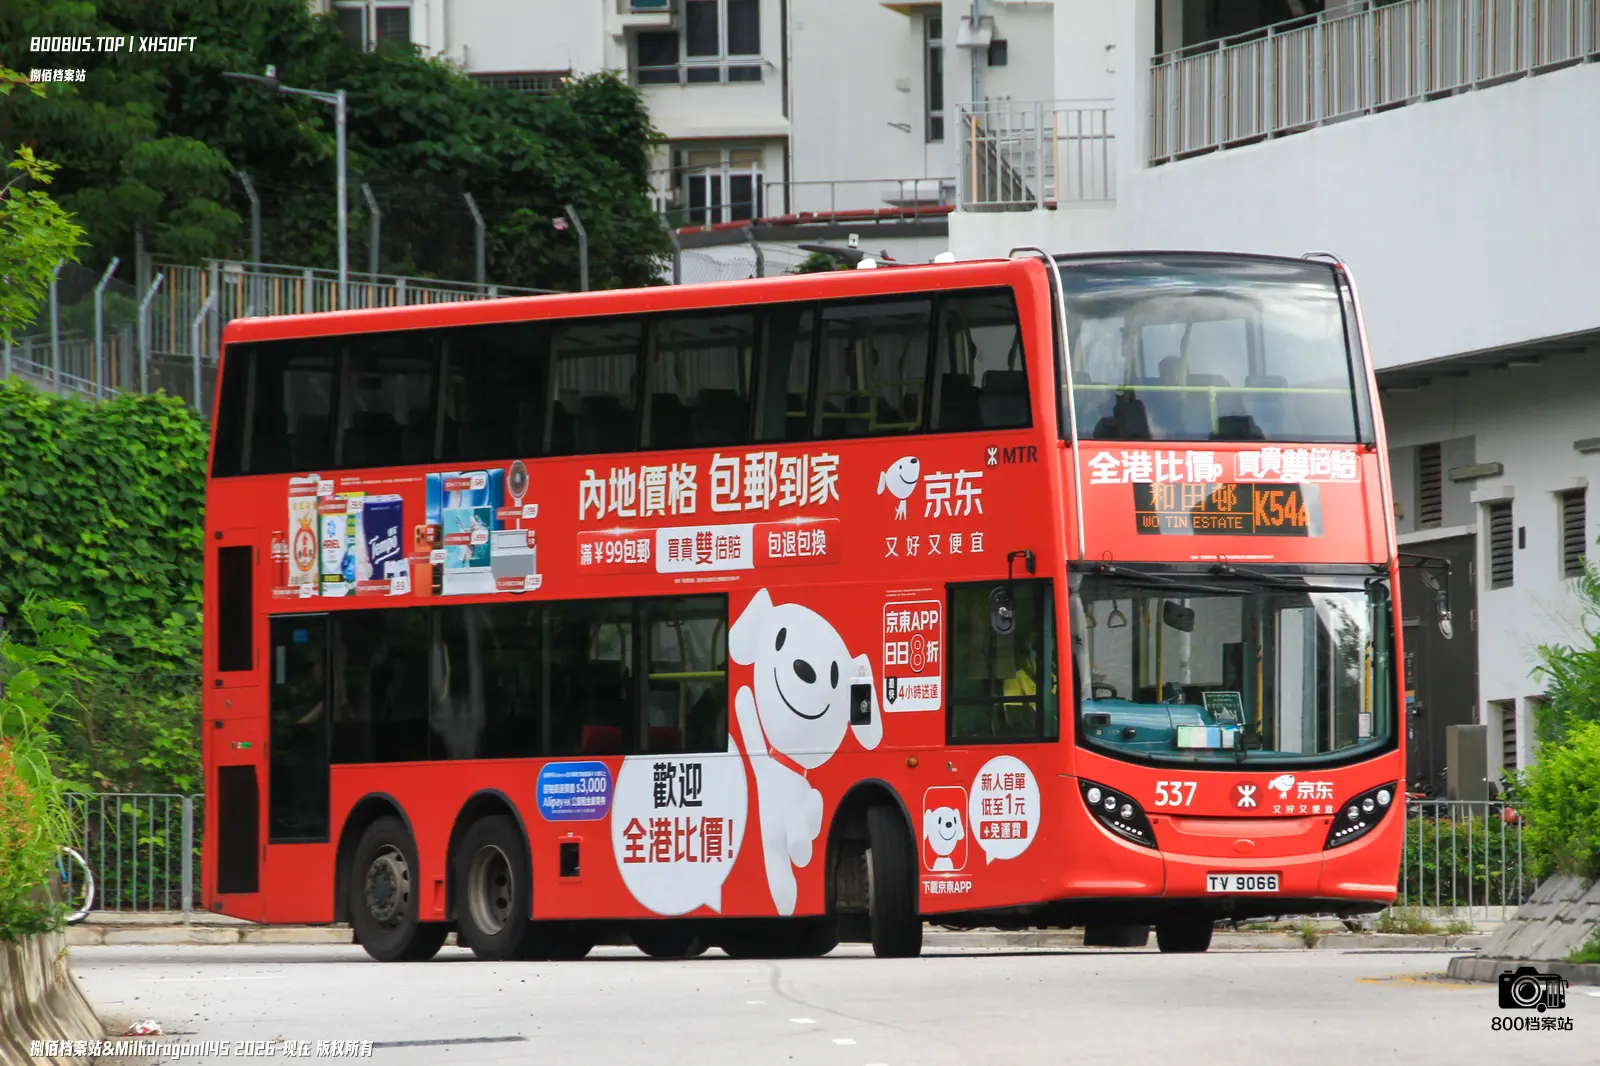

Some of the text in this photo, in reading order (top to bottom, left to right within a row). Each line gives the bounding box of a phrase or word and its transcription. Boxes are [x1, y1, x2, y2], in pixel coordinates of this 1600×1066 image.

[1003, 446, 1038, 464] MTR
[1088, 451, 1215, 485] 全港比價
[708, 451, 840, 513] 包郵到家
[923, 469, 984, 519] 京东
[1149, 482, 1238, 512] 和田邨
[1254, 490, 1311, 527] K54A
[1143, 515, 1243, 530] WO TIN ESTATE
[667, 531, 742, 566] 買貴雙倍賠
[767, 528, 827, 559] 包退包換
[885, 531, 984, 559] 又好又便宜
[885, 610, 939, 633] 京東APP
[885, 633, 939, 673] 日日8折
[653, 762, 703, 808] 歡迎
[981, 772, 1026, 791] 新人首單
[1154, 781, 1198, 807] 537
[1297, 781, 1334, 800] 京东
[981, 793, 1026, 816] 低至1元
[1272, 804, 1334, 814] 又好又便宜
[1209, 876, 1277, 891] TV 9066
